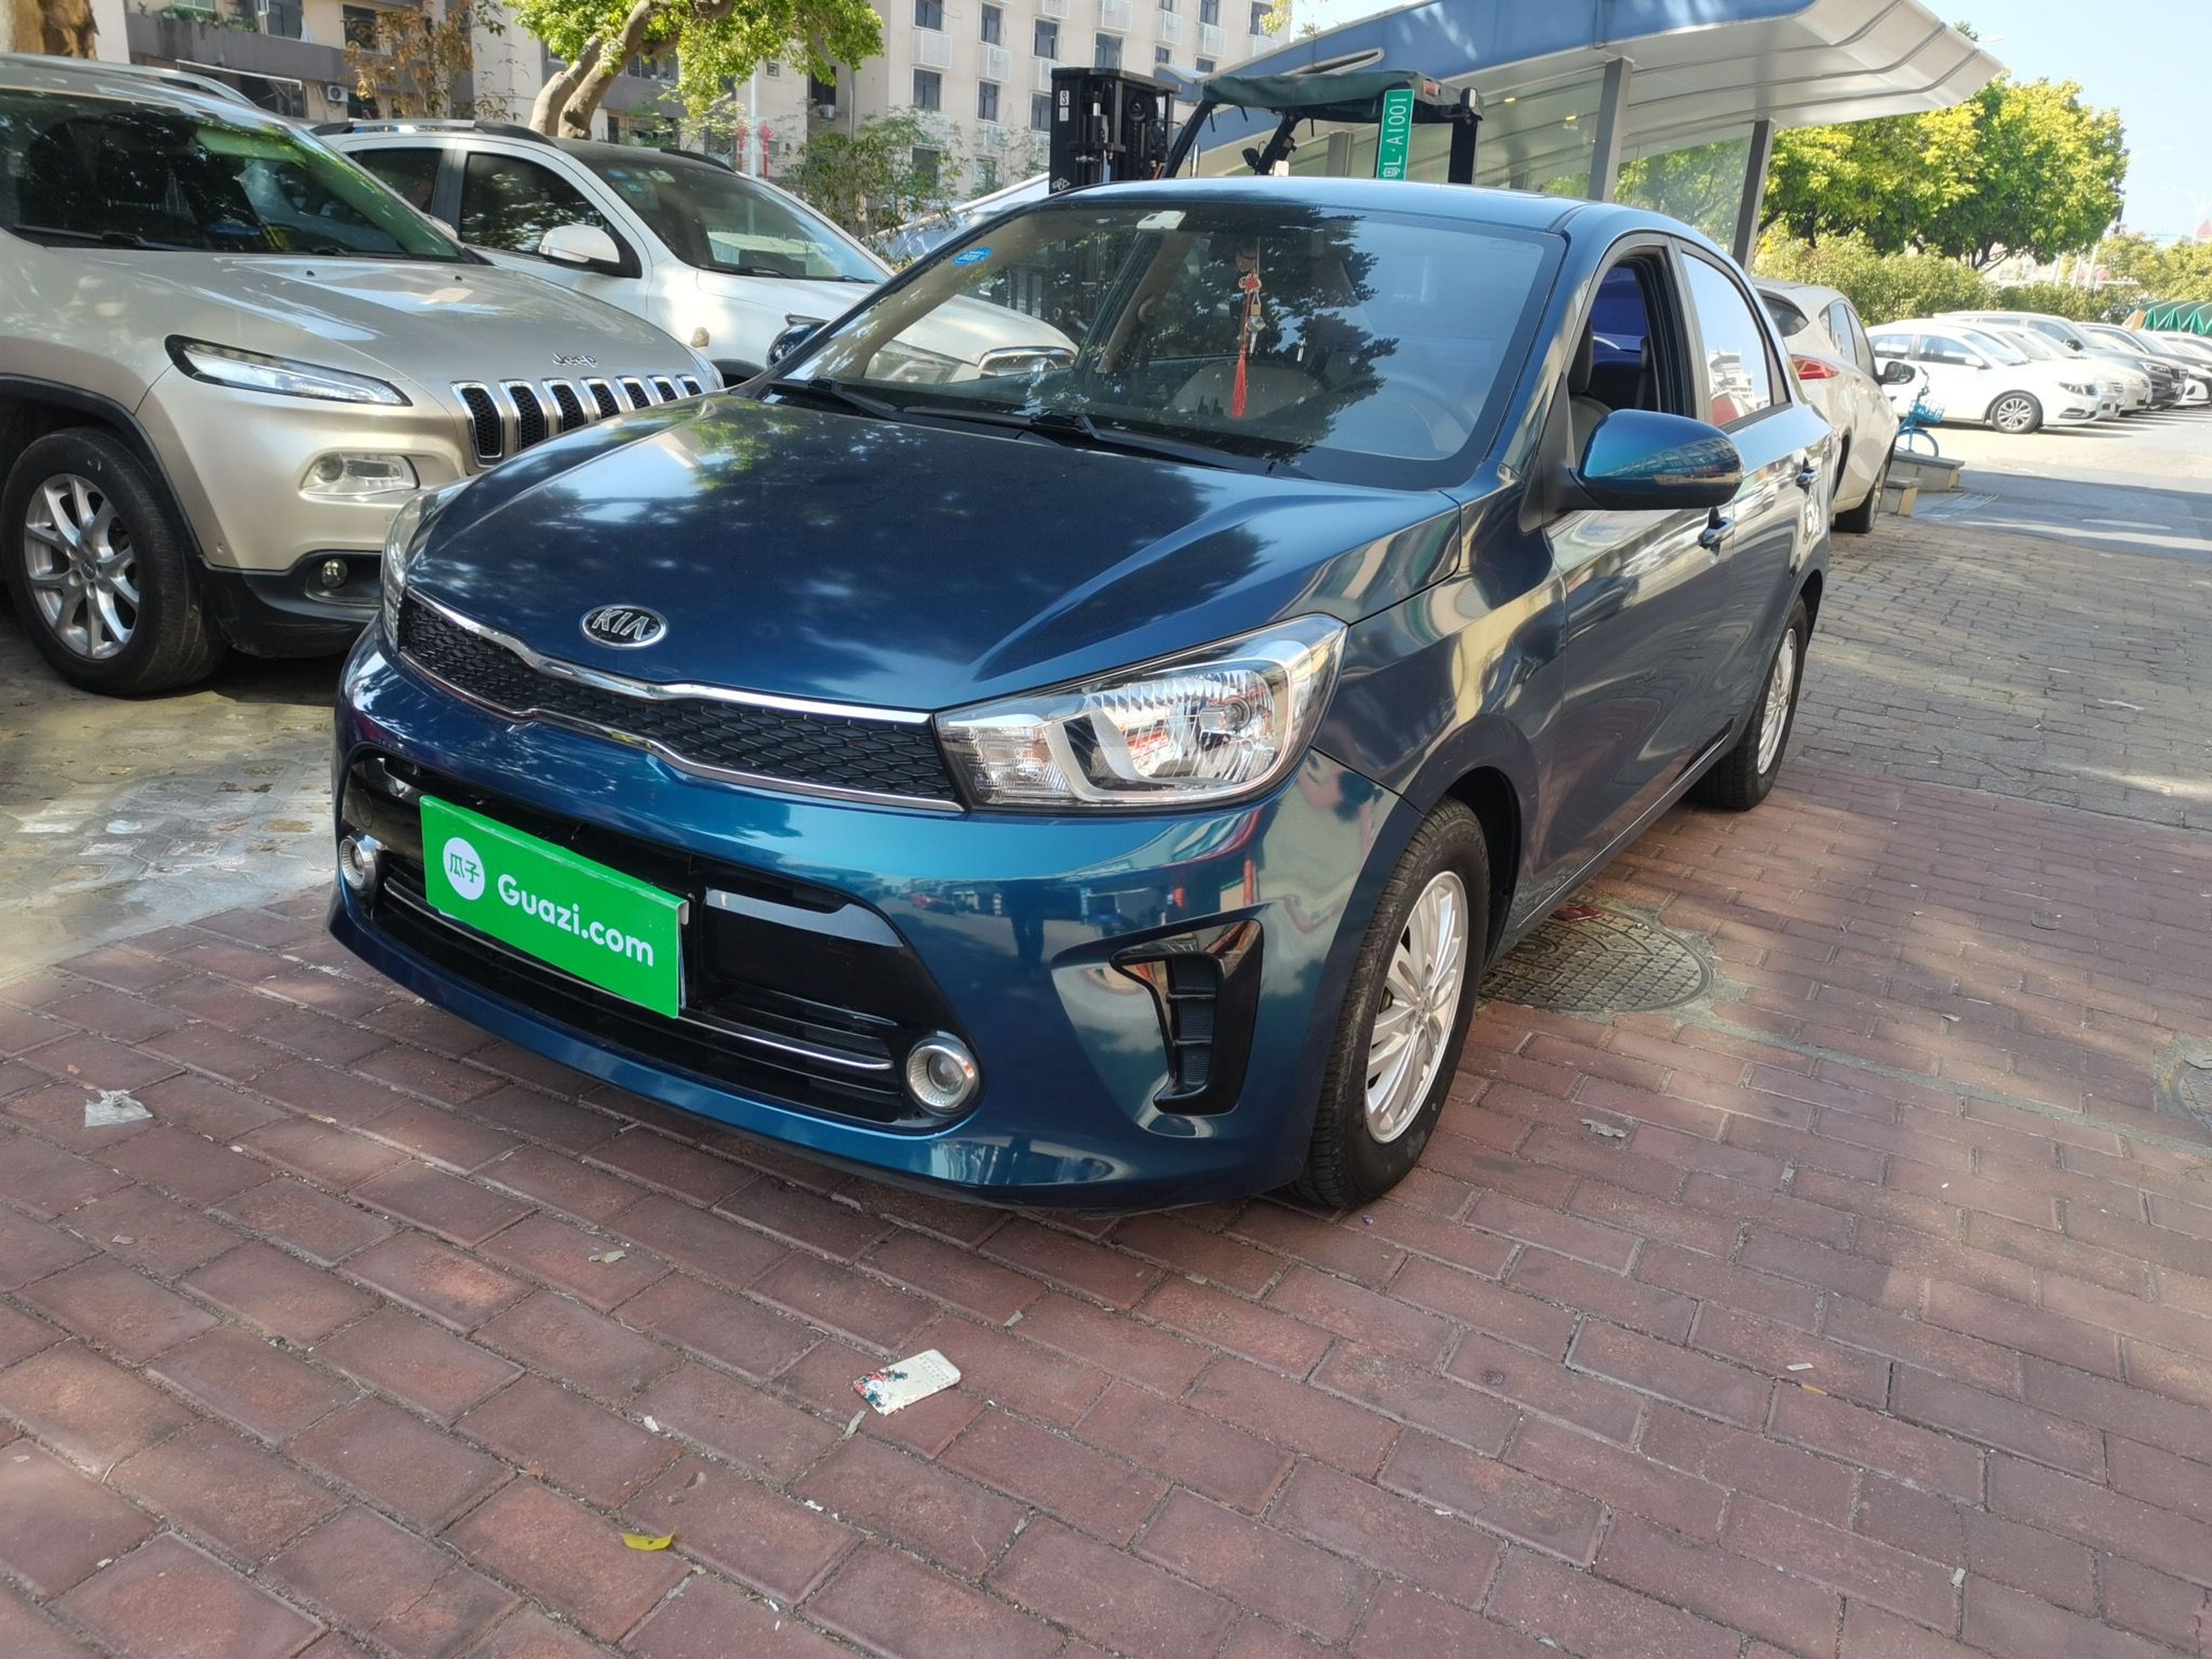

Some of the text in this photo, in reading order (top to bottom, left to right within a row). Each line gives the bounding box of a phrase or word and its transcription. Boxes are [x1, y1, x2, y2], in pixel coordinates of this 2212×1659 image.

[552, 352, 597, 368] Jeep
[592, 608, 649, 640] KIA
[449, 853, 480, 883] 瓜子
[498, 873, 654, 967] Guazi.com
